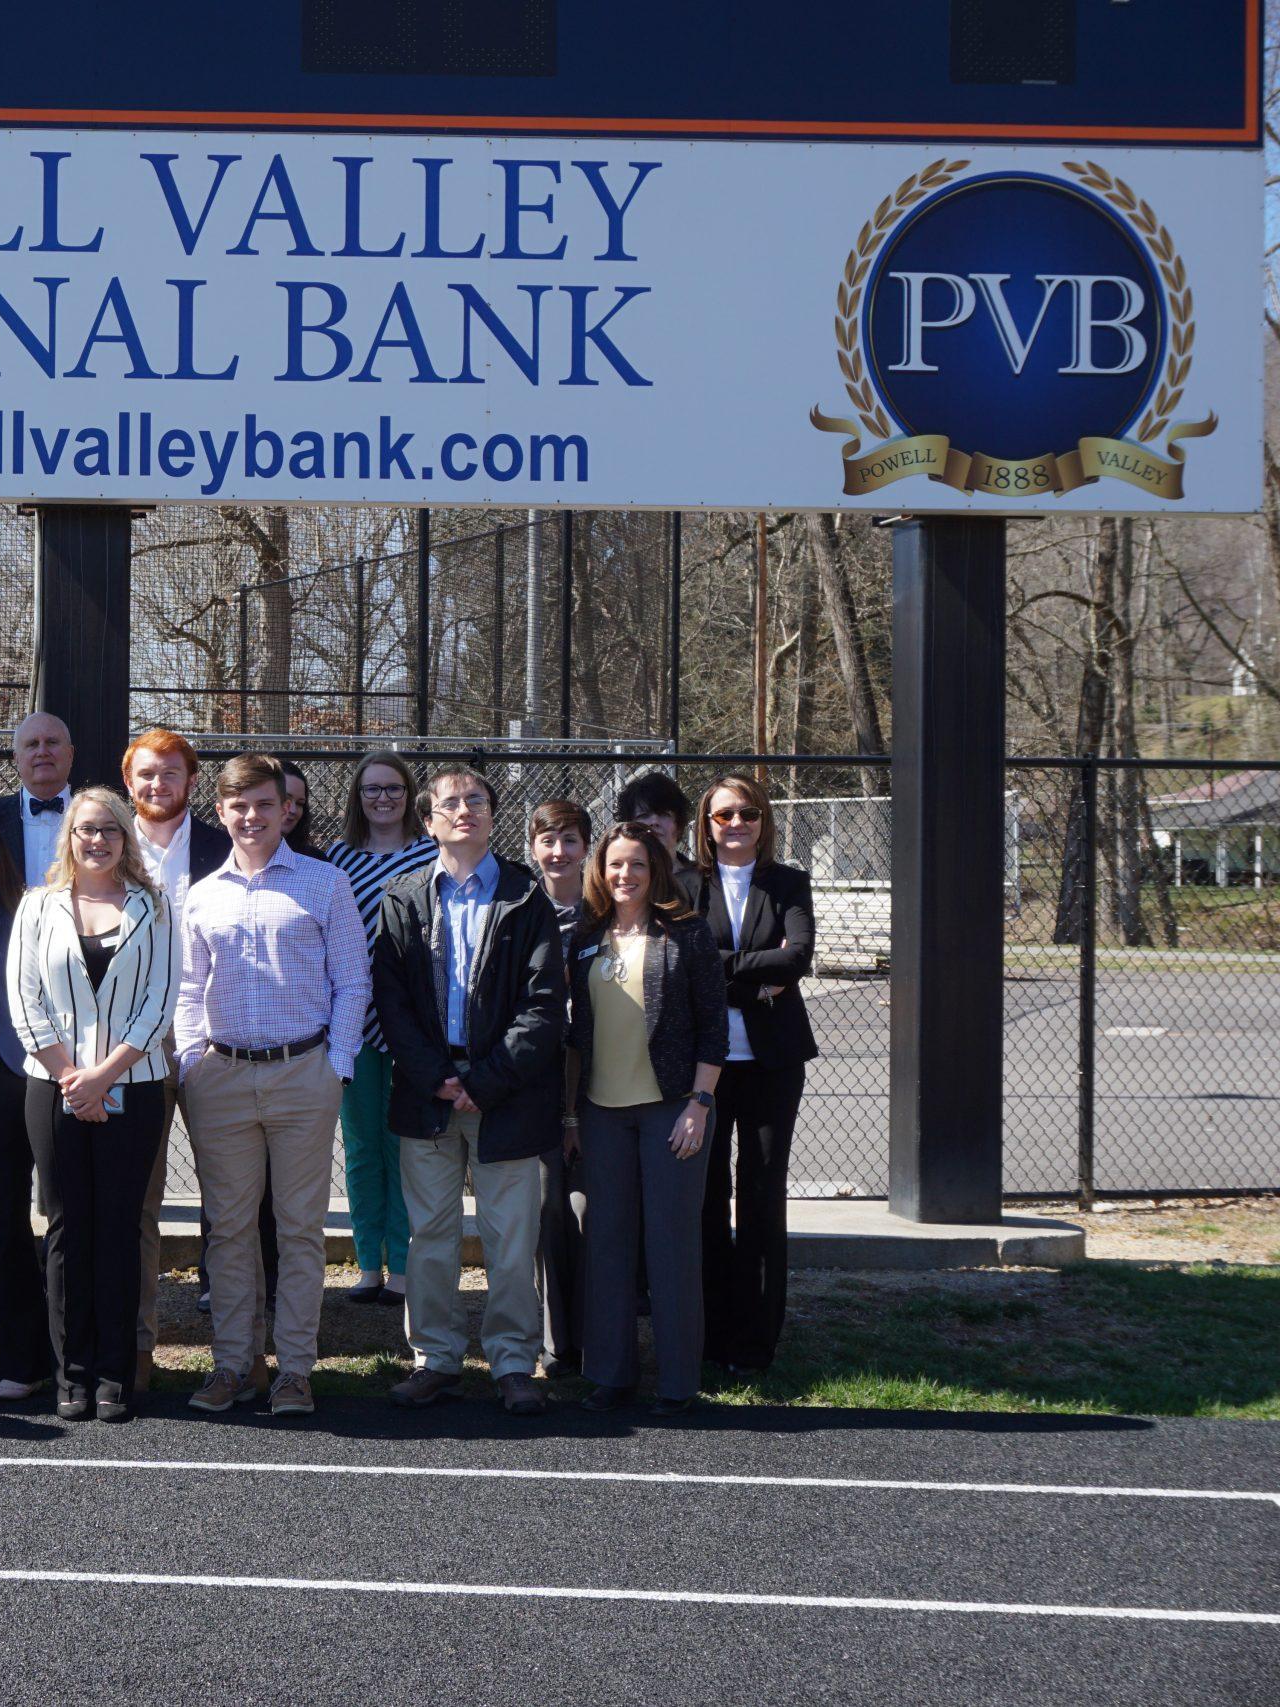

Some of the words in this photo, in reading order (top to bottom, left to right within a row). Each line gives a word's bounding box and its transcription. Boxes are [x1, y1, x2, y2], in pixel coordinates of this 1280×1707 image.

[140, 153, 663, 262] VALLEY
[274, 280, 654, 387] BANK
[888, 271, 1147, 374] PVB
[859, 448, 937, 483] POWELL
[982, 463, 1051, 490] 1888
[1096, 450, 1169, 485] VALLEY
